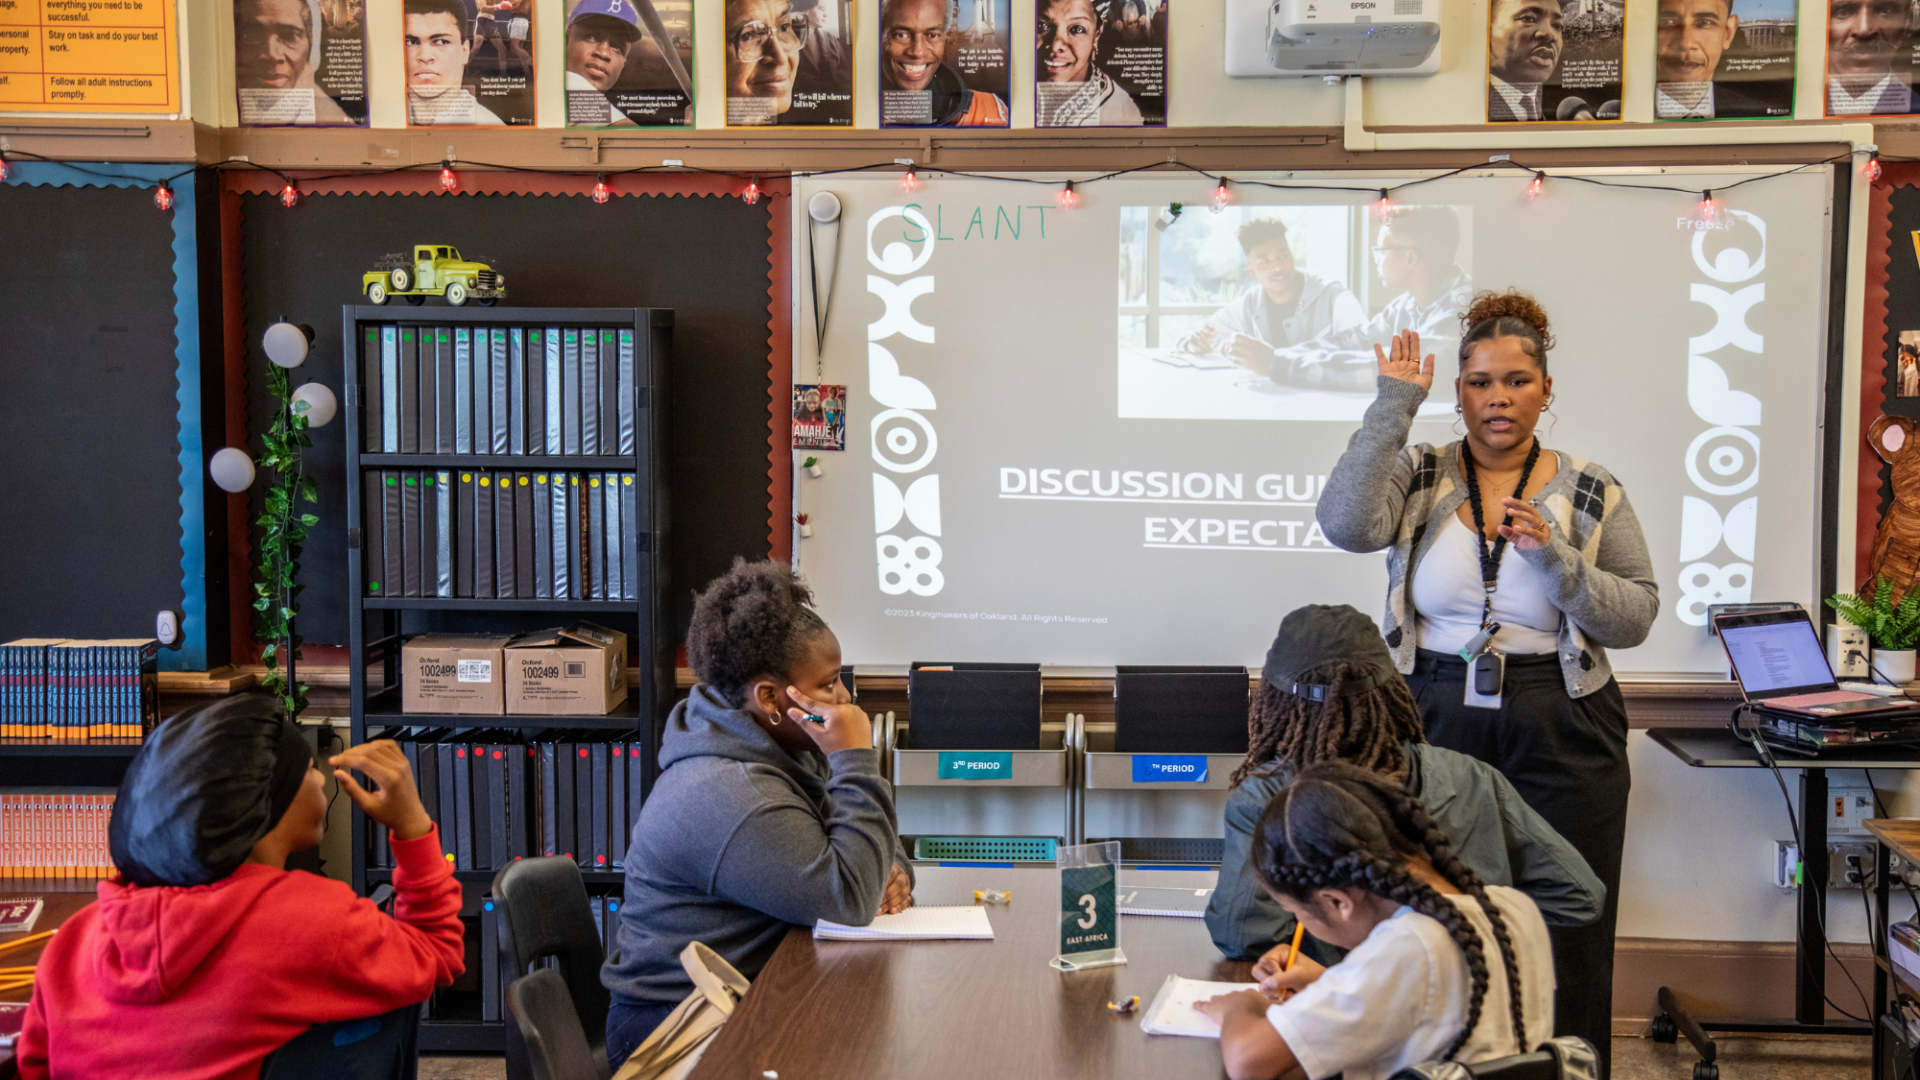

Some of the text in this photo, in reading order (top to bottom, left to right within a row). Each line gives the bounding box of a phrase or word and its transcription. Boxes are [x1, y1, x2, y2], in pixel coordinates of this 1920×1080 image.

[47, 1, 142, 11] everything you need to be
[48, 13, 90, 21] successful.
[49, 30, 66, 41] Stay
[79, 31, 94, 39] task
[97, 32, 110, 40] and
[112, 32, 121, 40] do
[124, 34, 139, 42] your
[142, 32, 158, 40] best
[51, 77, 152, 87] Follow all adult instructions
[51, 90, 86, 100] promptly.
[902, 203, 1056, 242] SLANT
[1000, 467, 1243, 499] DISCUSSION
[885, 609, 914, 617] ©2023
[916, 610, 967, 620] Kingmakers
[969, 611, 978, 619] of
[980, 612, 1018, 621] Oakland.
[1034, 614, 1063, 624] Rights
[1065, 615, 1108, 624] Reserved
[420, 665, 456, 677] 1002499
[523, 667, 559, 678] 1002499
[967, 761, 1000, 770] PERIOD
[1161, 765, 1195, 773] PERIOD
[1077, 894, 1097, 929] 3
[1066, 933, 1108, 945] EAST AFRICA
